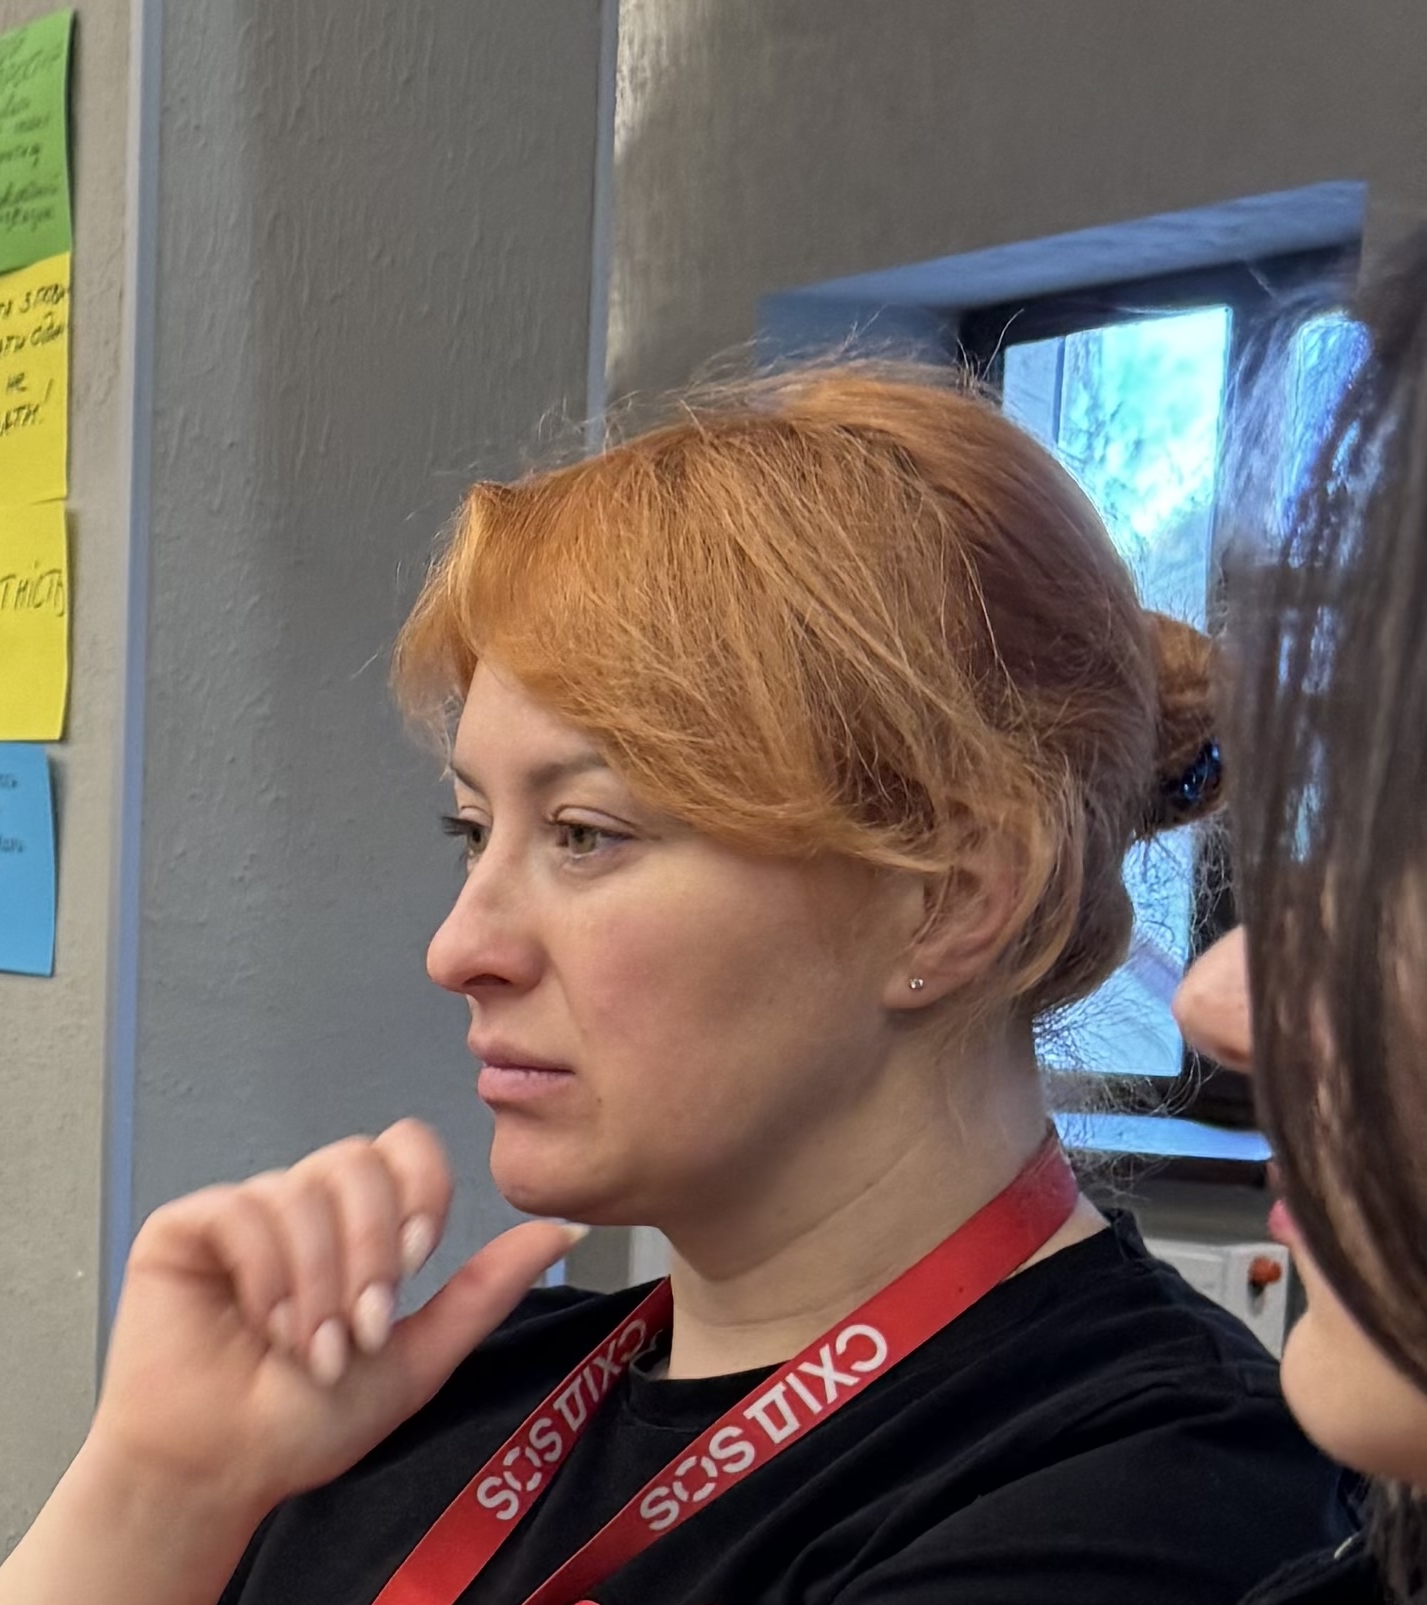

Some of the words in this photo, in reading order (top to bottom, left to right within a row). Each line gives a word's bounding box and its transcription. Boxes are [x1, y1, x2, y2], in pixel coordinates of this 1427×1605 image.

[19, 292, 31, 313] З
[553, 1317, 649, 1429] СХІД
[742, 1323, 890, 1444] СХІД
[476, 1416, 563, 1522] SOS
[639, 1425, 757, 1532] SOS
